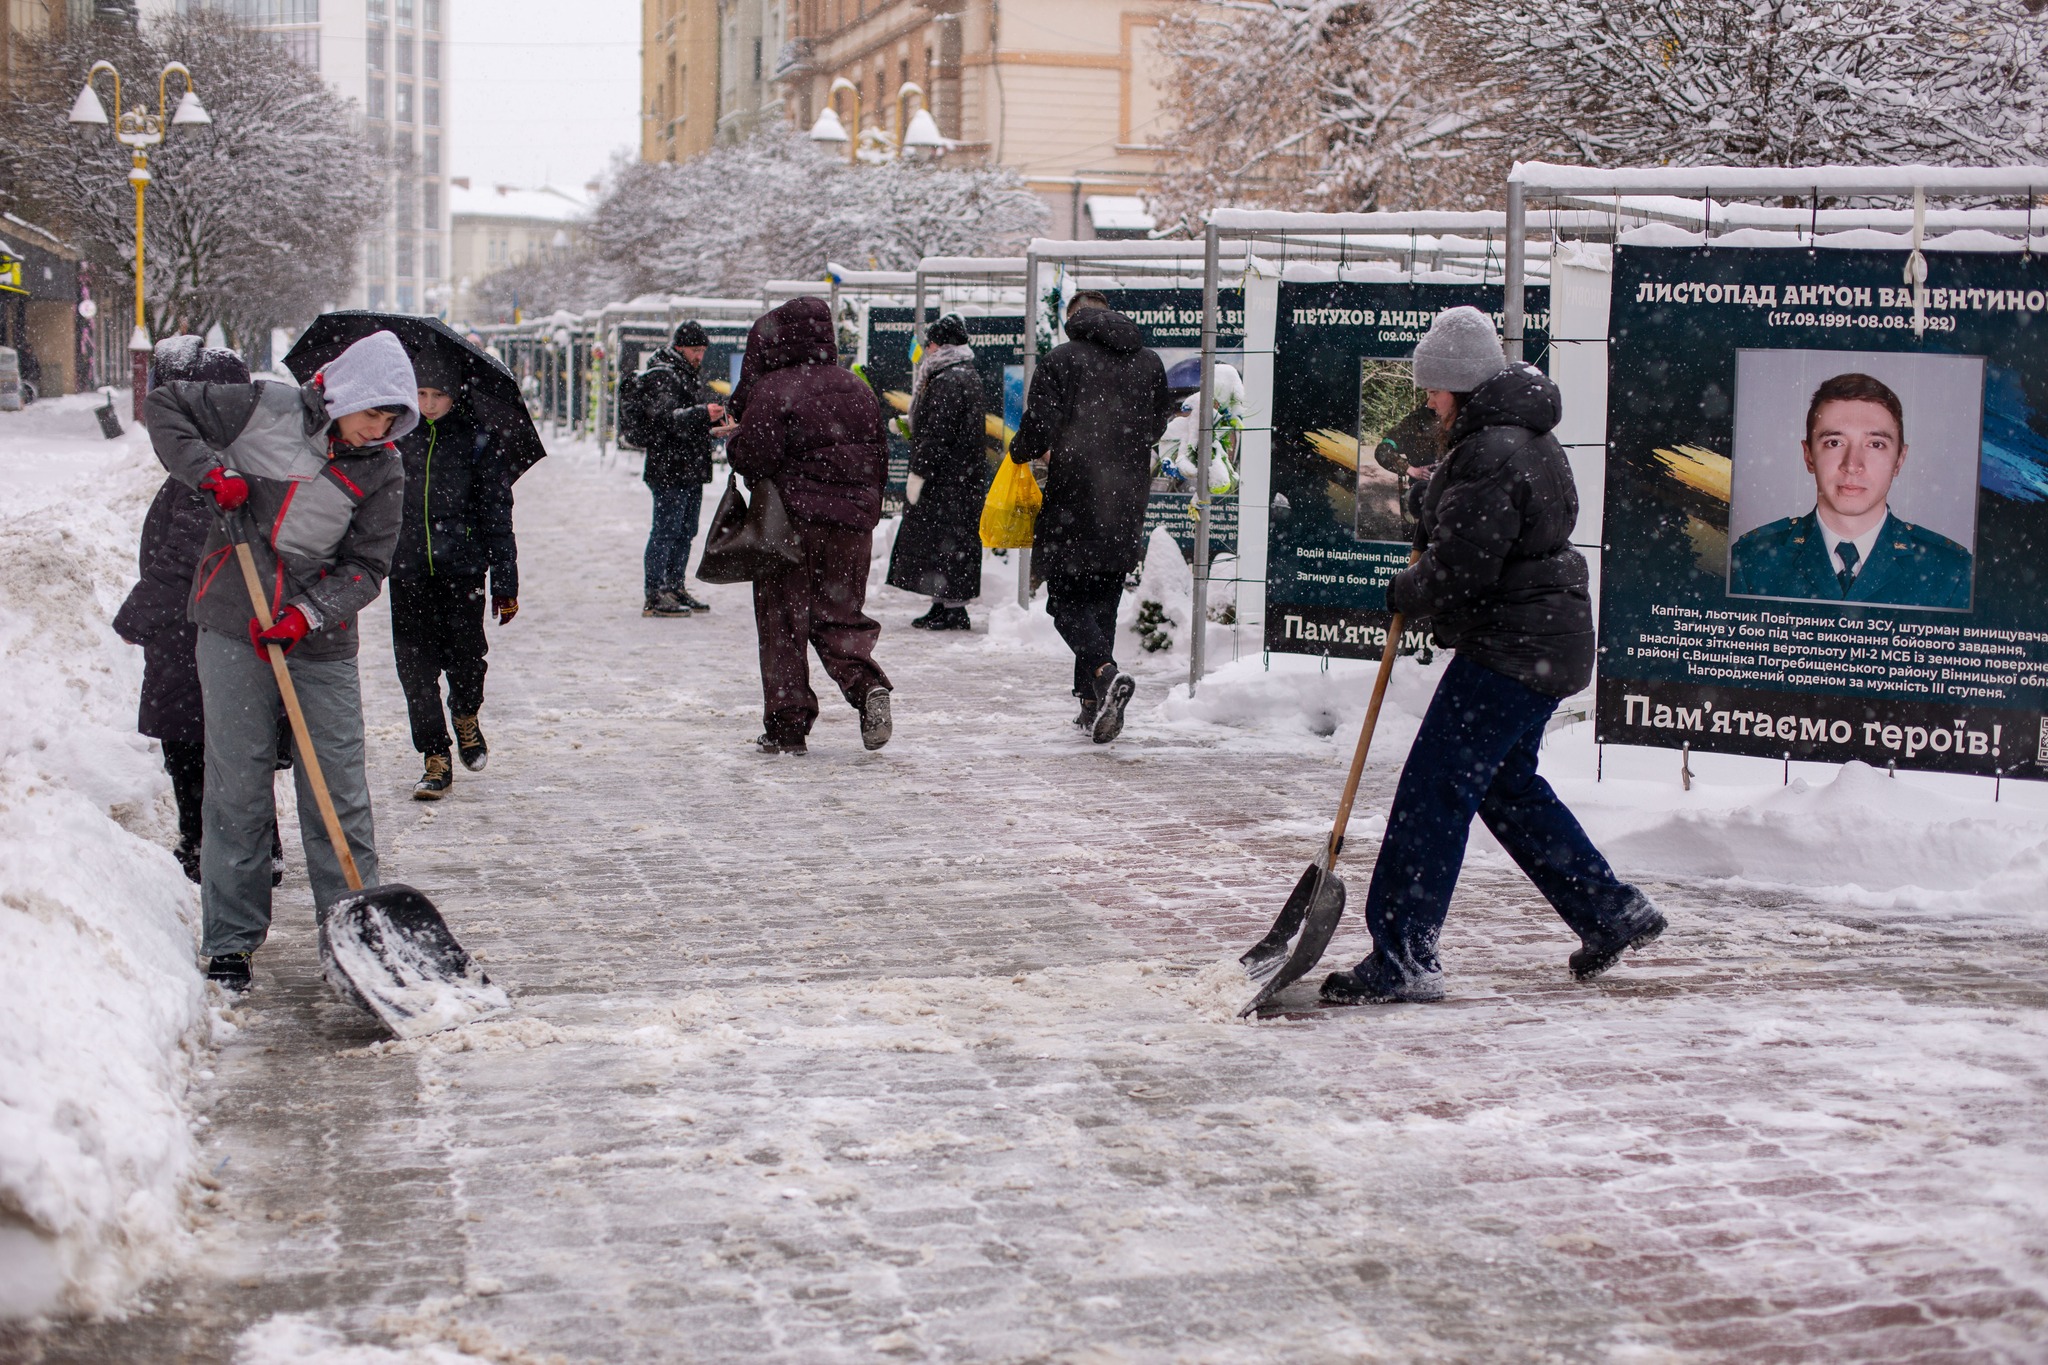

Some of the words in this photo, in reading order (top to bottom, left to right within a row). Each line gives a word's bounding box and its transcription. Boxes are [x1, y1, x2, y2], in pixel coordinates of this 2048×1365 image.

[1636, 282, 1777, 308] ЛИСТОПАД
[1782, 284, 1872, 307] АНТОН
[1878, 287, 2048, 311] ВАЛЕНТИНО
[1293, 308, 1375, 325] ПЕТУХОВ
[1296, 547, 1324, 559] Водій
[1327, 549, 1380, 561] відділення
[1296, 571, 1336, 584] Загинув
[1347, 574, 1367, 585] бою
[1369, 578, 1375, 586] в
[1284, 615, 1434, 649] Пам’ятамо
[1651, 605, 1702, 619] Капітан,
[1705, 609, 1757, 622] льотчик
[1761, 612, 1835, 627] Повітряних
[1838, 617, 1863, 629] Сил
[1867, 619, 1896, 634] ЗСУ,
[1899, 623, 1959, 636] штурман
[1640, 633, 1703, 647] внаслідок
[1706, 636, 1769, 651] зіткнення
[1773, 643, 1847, 660] вертольоту
[1881, 650, 1910, 662] МСБ
[1914, 652, 1924, 663] із
[1928, 655, 1981, 667] земною
[1985, 658, 2048, 673] поверхне
[1673, 620, 1725, 635] Загинув
[1728, 624, 1735, 637] у
[1739, 622, 1765, 637] бою
[1768, 627, 1788, 640] під
[1792, 630, 1814, 641] час
[1817, 633, 1888, 646] виконання
[1892, 636, 1955, 650] бойового
[1959, 641, 2026, 657] завдання,
[1627, 647, 1634, 656] в
[1637, 645, 1680, 660] районі
[1682, 650, 1754, 665] с.Вишнівка
[1758, 655, 1886, 675] Погребищенського
[1889, 666, 1938, 681] району
[1941, 669, 2017, 685] Вінницької
[1688, 664, 1784, 682] Нагороджений
[1788, 673, 1846, 686] орденом
[1849, 679, 1863, 688] за
[1867, 678, 1928, 693] мужність
[1948, 684, 2006, 699] ступеня.
[1623, 694, 1852, 744] Пам’ятаємо
[1862, 719, 2002, 758] героїв!
